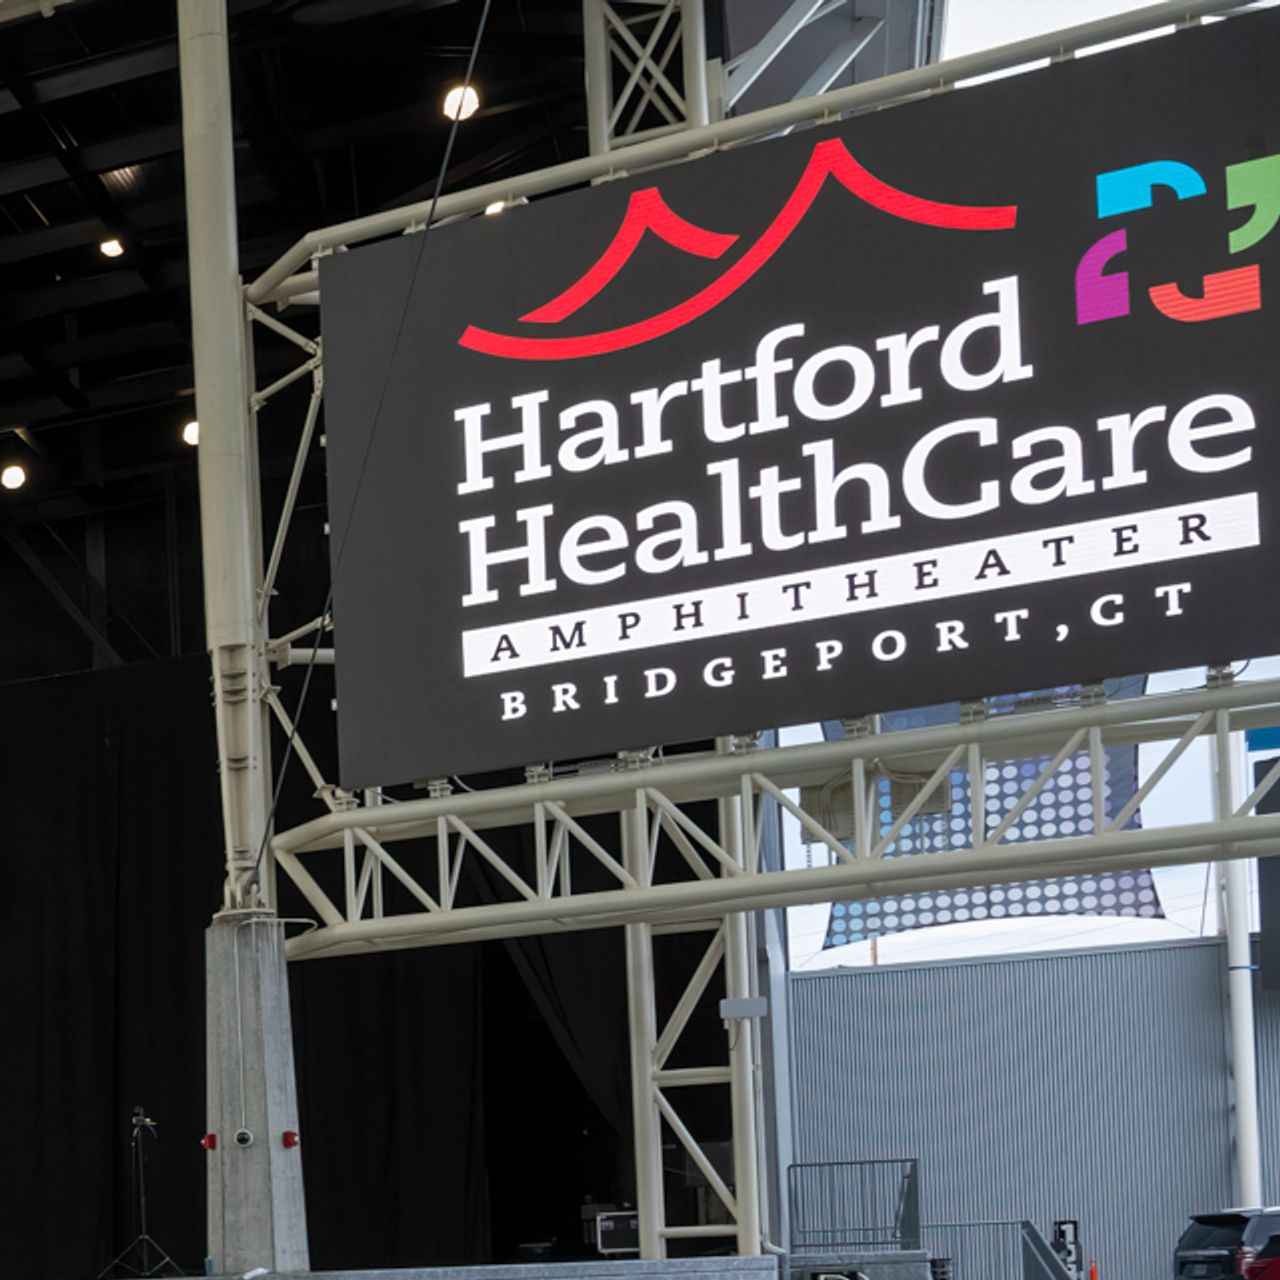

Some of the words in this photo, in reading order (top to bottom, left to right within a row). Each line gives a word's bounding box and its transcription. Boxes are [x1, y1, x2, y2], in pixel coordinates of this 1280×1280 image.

[453, 274, 1034, 496] Hartford
[458, 393, 1257, 608] HealthCare
[490, 513, 1213, 662] AMPHITHEATER
